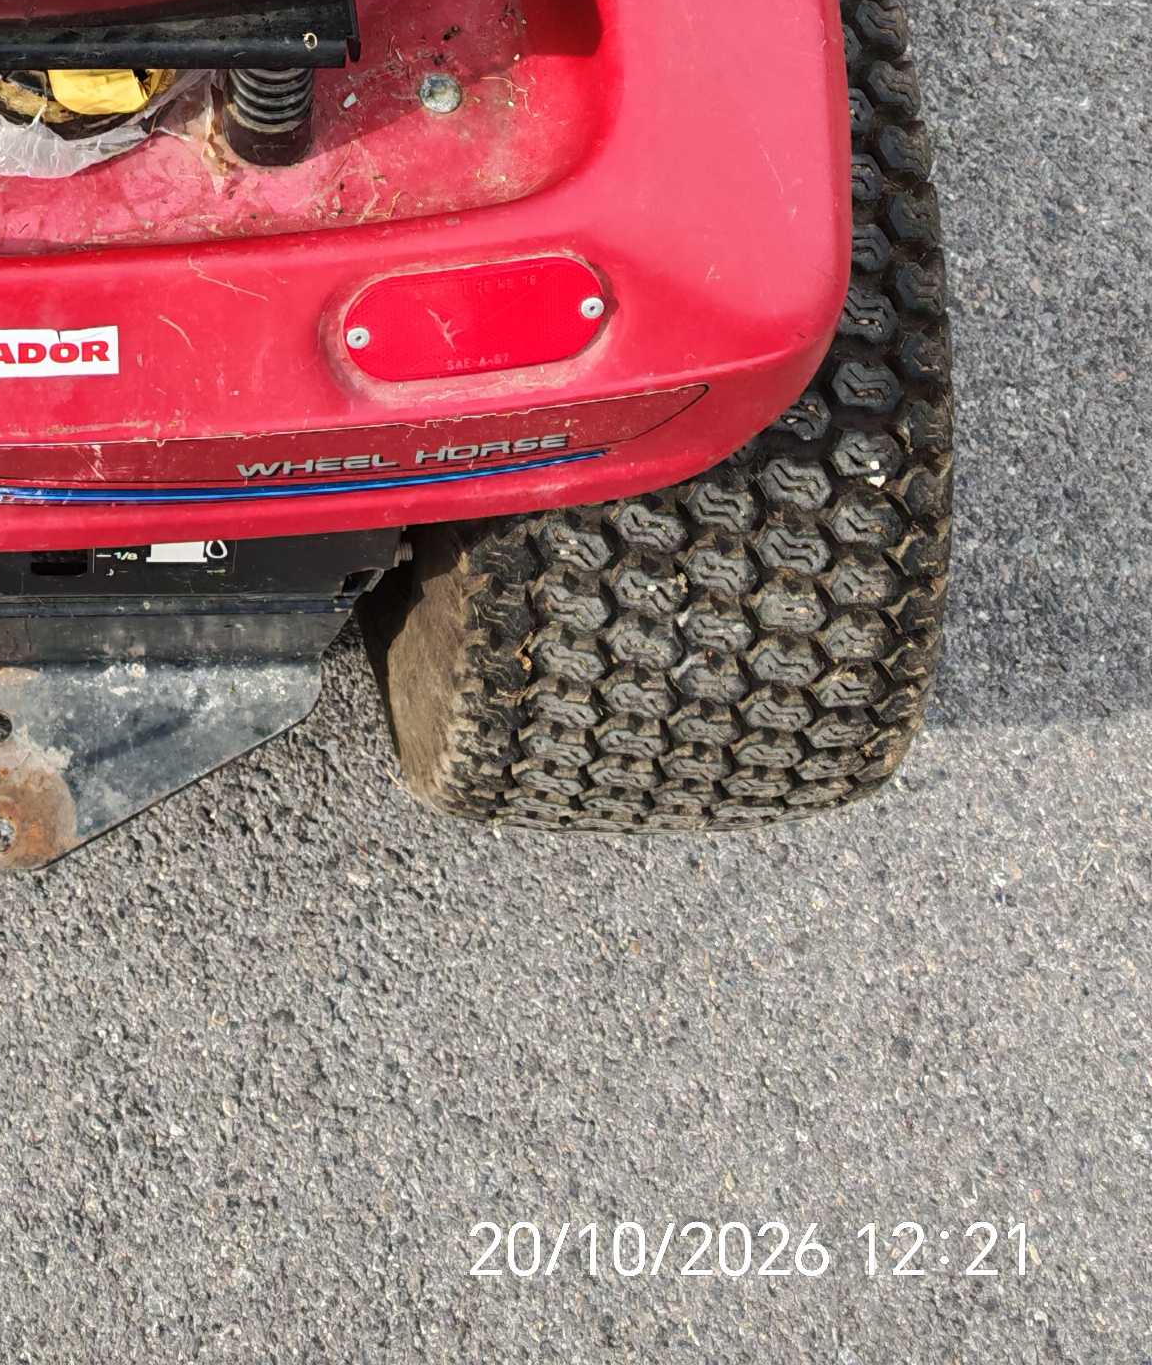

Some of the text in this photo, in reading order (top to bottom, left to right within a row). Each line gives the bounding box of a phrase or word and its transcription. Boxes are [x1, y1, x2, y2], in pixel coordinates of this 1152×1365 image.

[235, 433, 571, 478] WHEEL HORSE
[113, 551, 139, 561] 1/8
